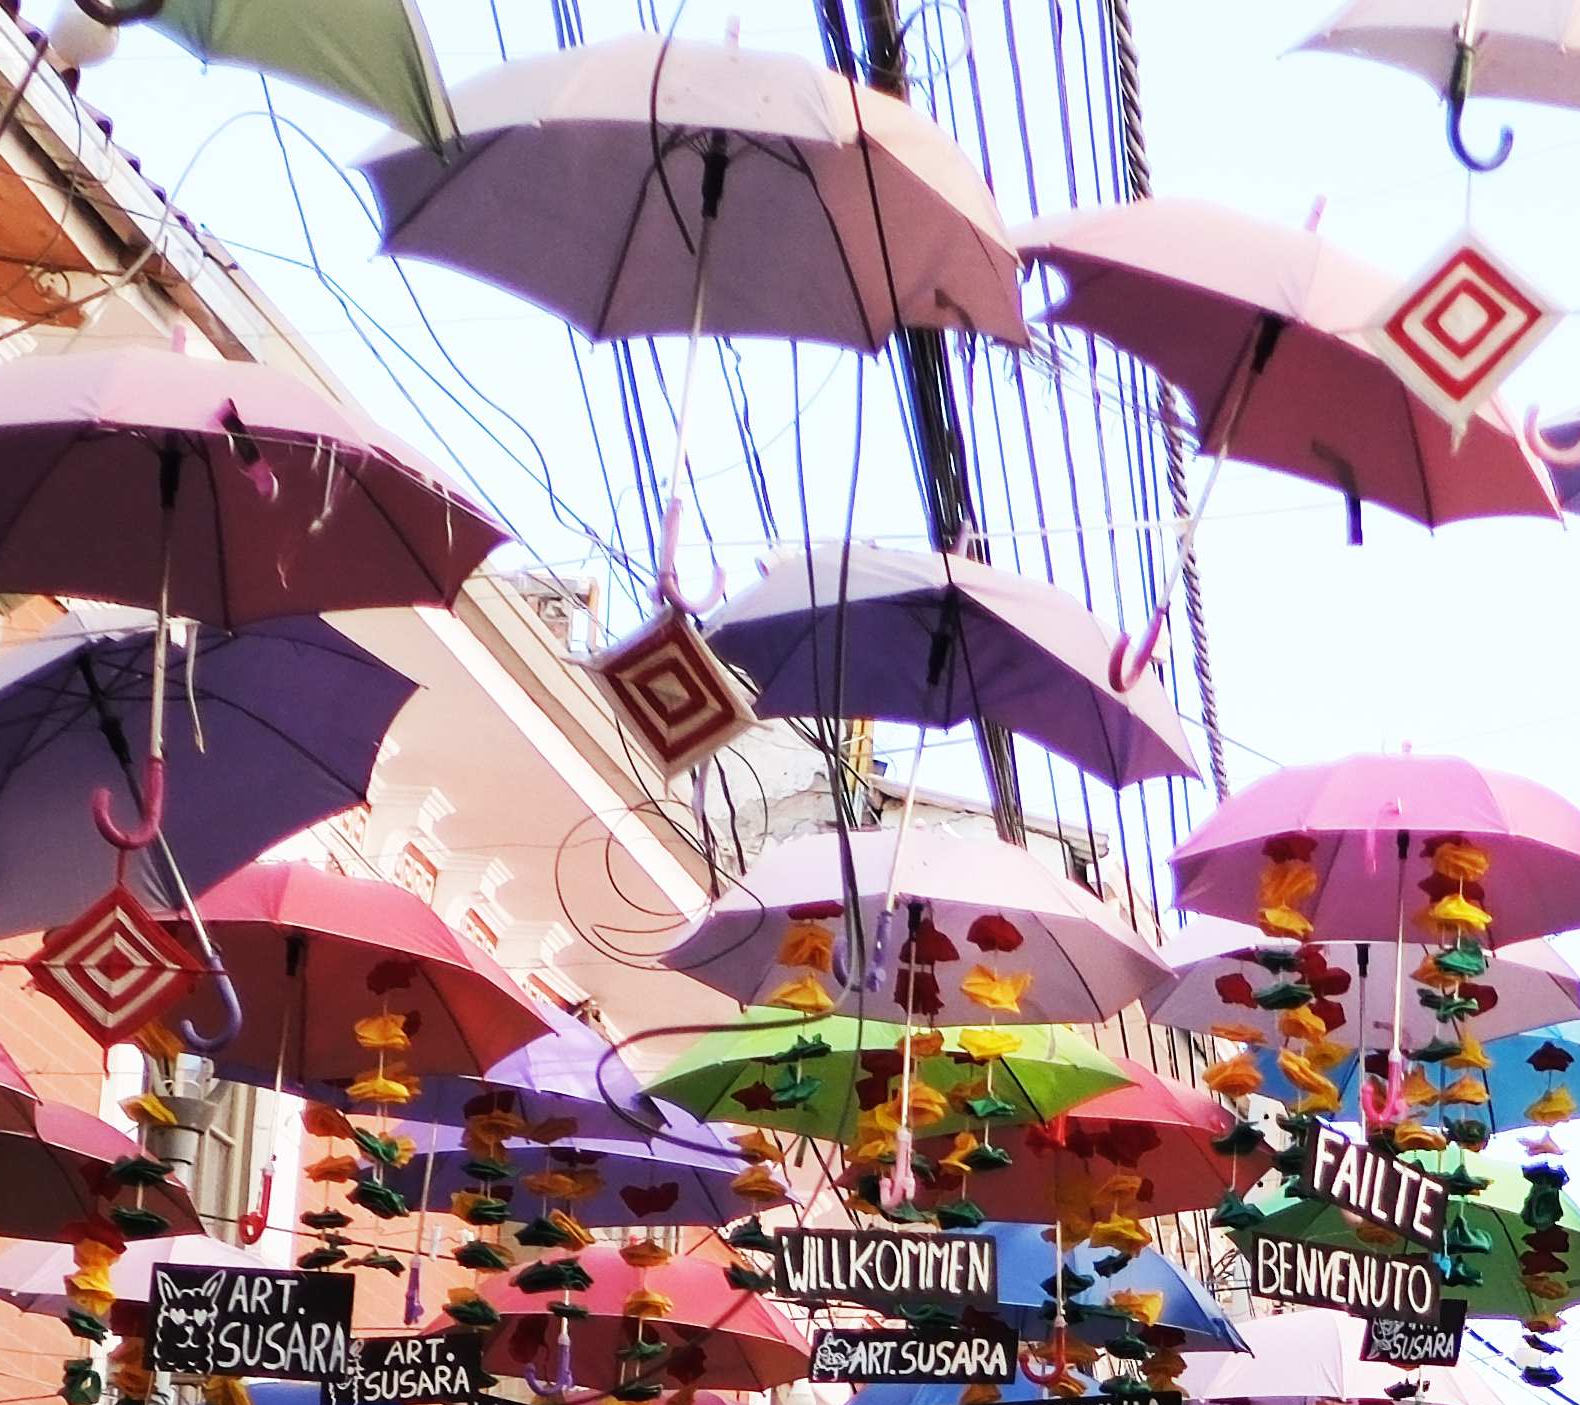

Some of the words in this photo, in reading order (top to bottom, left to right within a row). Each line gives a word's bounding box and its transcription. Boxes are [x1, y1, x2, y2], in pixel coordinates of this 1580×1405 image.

[1311, 1126, 1446, 1241] FAILTE
[781, 1234, 994, 1295] WILLKOMMEN
[1256, 1235, 1434, 1315] BENVENUTO
[229, 1275, 307, 1315] ART.
[218, 1320, 349, 1374] SUSARA
[384, 1337, 456, 1365] ART.
[895, 1336, 1010, 1379] SUSARA
[1389, 1332, 1455, 1361] SUSARA
[364, 1365, 472, 1402] SUSARA
